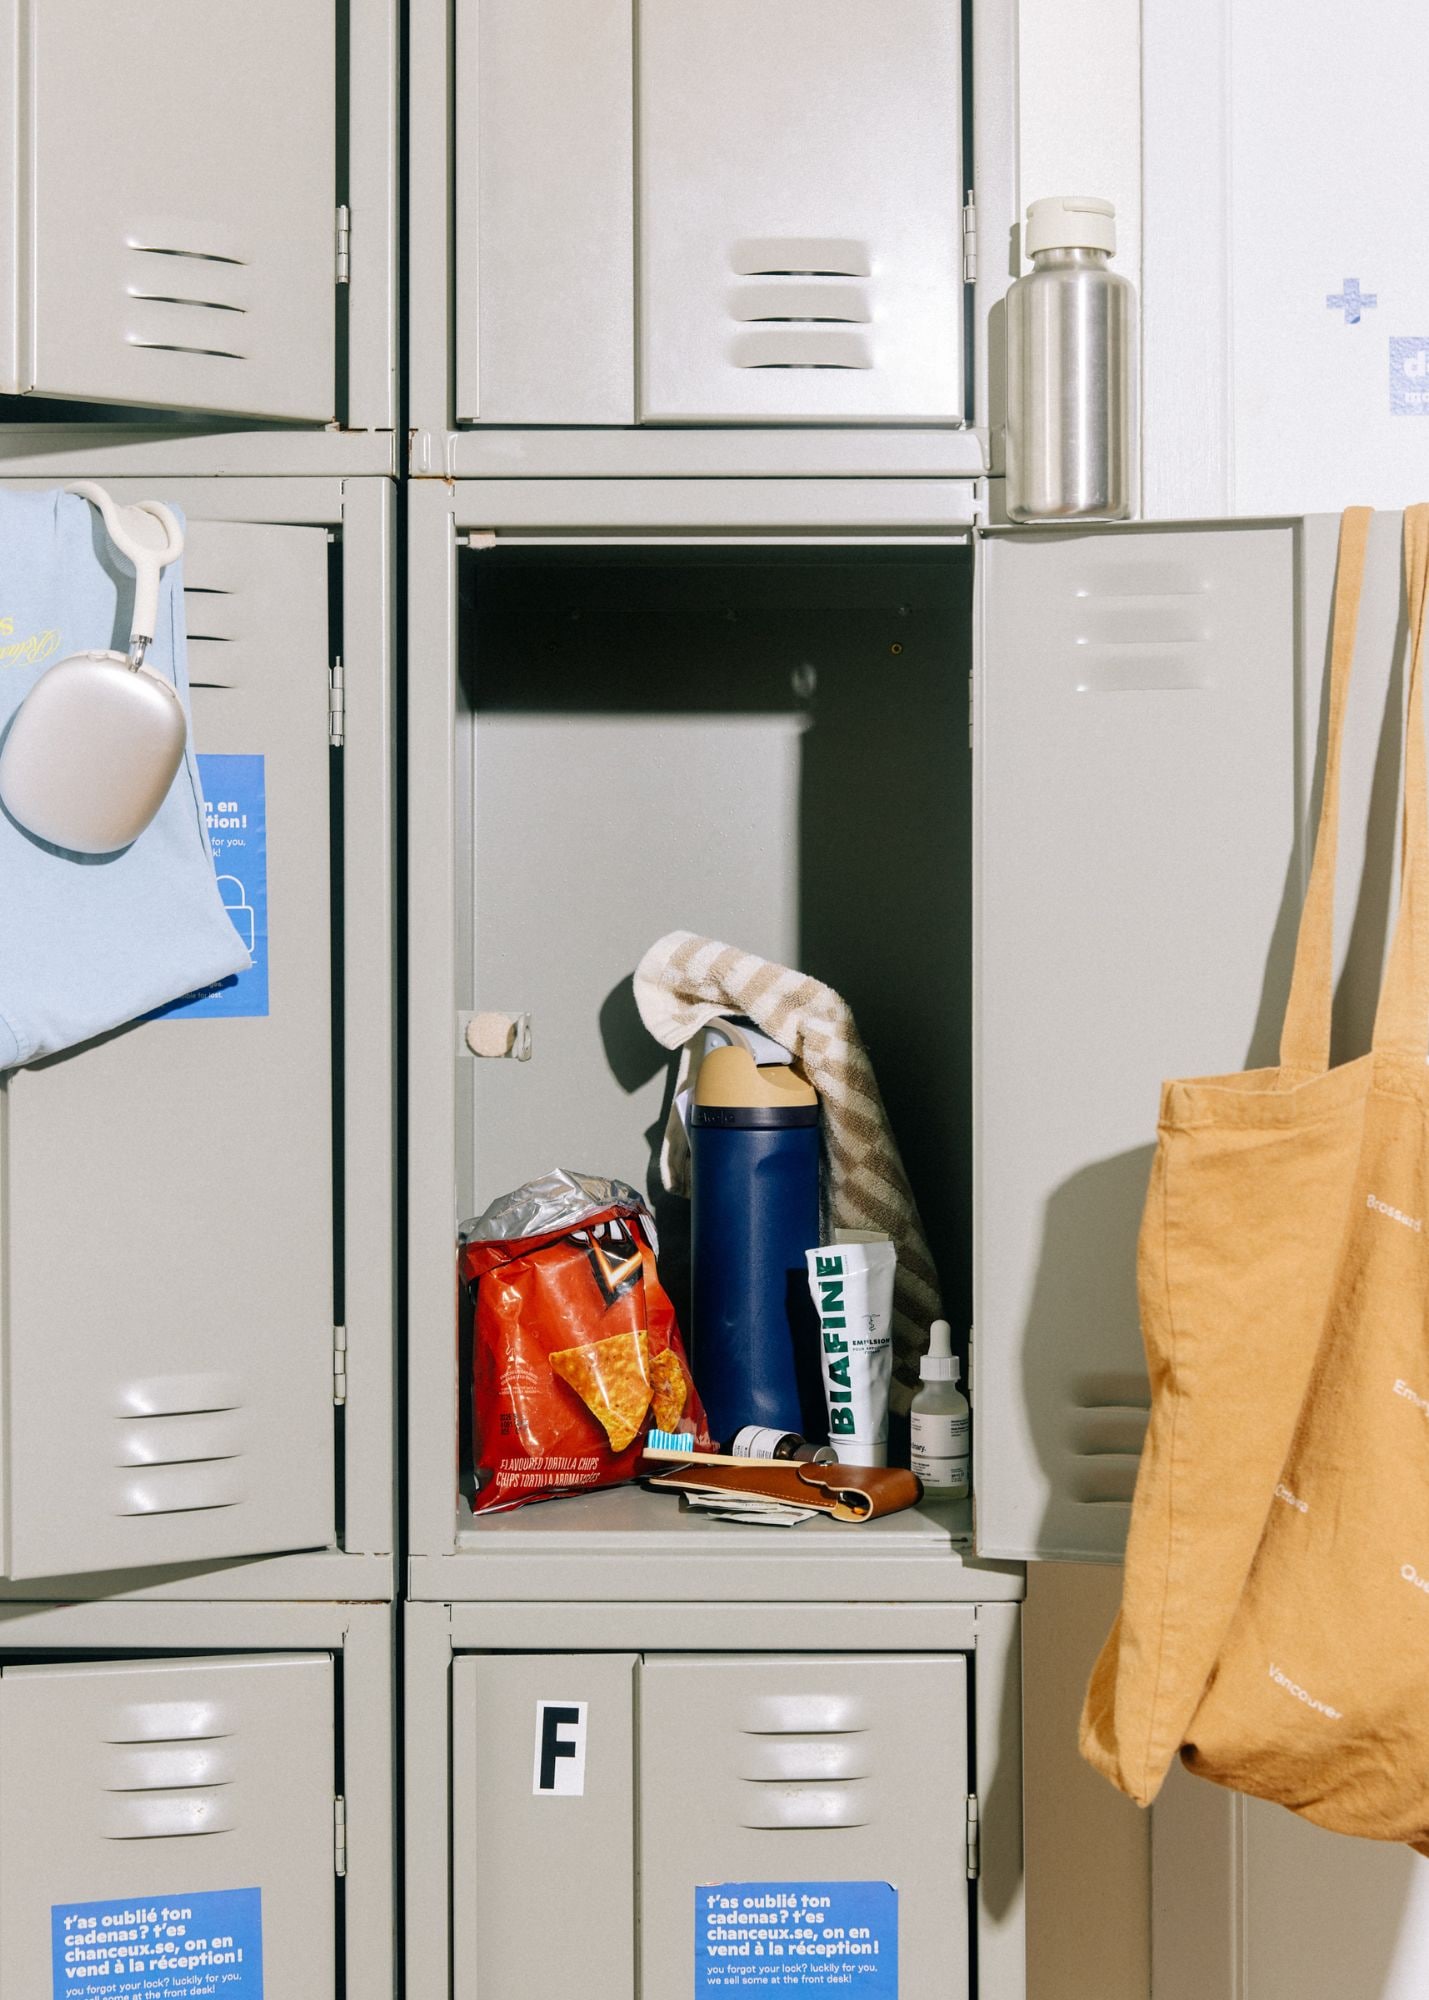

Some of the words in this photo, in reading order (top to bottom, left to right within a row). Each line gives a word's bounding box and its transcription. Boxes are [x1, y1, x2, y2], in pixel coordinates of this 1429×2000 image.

[1403, 350, 1429, 377] d
[204, 802, 213, 812] n
[218, 801, 238, 812] en
[206, 814, 247, 828] tion!
[211, 837, 224, 846] for
[1366, 1194, 1422, 1232] Brossard
[816, 1255, 855, 1434] BIAFINE
[500, 1457, 543, 1471] FLAVOURED
[544, 1457, 577, 1471] TORTILLA
[577, 1457, 599, 1471] CHIPS
[496, 1471, 519, 1487] CHIPS
[1268, 1662, 1344, 1719] Vancouver
[540, 1706, 579, 1789] F
[706, 1894, 739, 1909] t'as
[742, 1893, 798, 1909] oublié
[801, 1894, 831, 1908] ton
[63, 1915, 97, 1930] t'as
[101, 1908, 157, 1927] oublié
[161, 1907, 192, 1921] ton
[792, 1909, 825, 1924] t'es
[153, 1922, 186, 1938] t'es
[707, 1926, 819, 1942] chanceux.se,
[822, 1927, 845, 1939] on
[848, 1927, 870, 1939] en
[64, 1942, 180, 1963] chanceux.se,
[184, 1938, 207, 1951] on
[211, 1936, 233, 1949] en
[706, 1941, 750, 1956] vend
[754, 1941, 765, 1956] à
[768, 1941, 784, 1955] la
[65, 1960, 110, 1979] vend
[114, 1959, 125, 1974] à
[129, 1958, 145, 1973] la
[707, 1966, 725, 1975] you
[727, 1964, 756, 1975] forgot
[758, 1965, 780, 1975] your
[782, 1963, 807, 1973] lock?
[810, 1963, 839, 1973] luckily
[842, 1962, 855, 1972] for
[66, 1988, 84, 1998] you
[86, 1984, 117, 1995] forgot
[119, 1982, 141, 1993] your
[143, 1977, 170, 1989] lock?
[172, 1974, 203, 1986] luckily
[204, 1973, 219, 1984] for
[707, 1977, 721, 1985] we
[724, 1975, 740, 1985] sell
[742, 1977, 768, 1985] some
[771, 1976, 781, 1984] at
[783, 1974, 799, 1984] the
[801, 1974, 824, 1984] front
[826, 1974, 852, 1984] desk!
[132, 1992, 143, 2000] at
[144, 1989, 161, 1999] the
[163, 1987, 187, 1998] front
[189, 1983, 216, 1996] desk!
